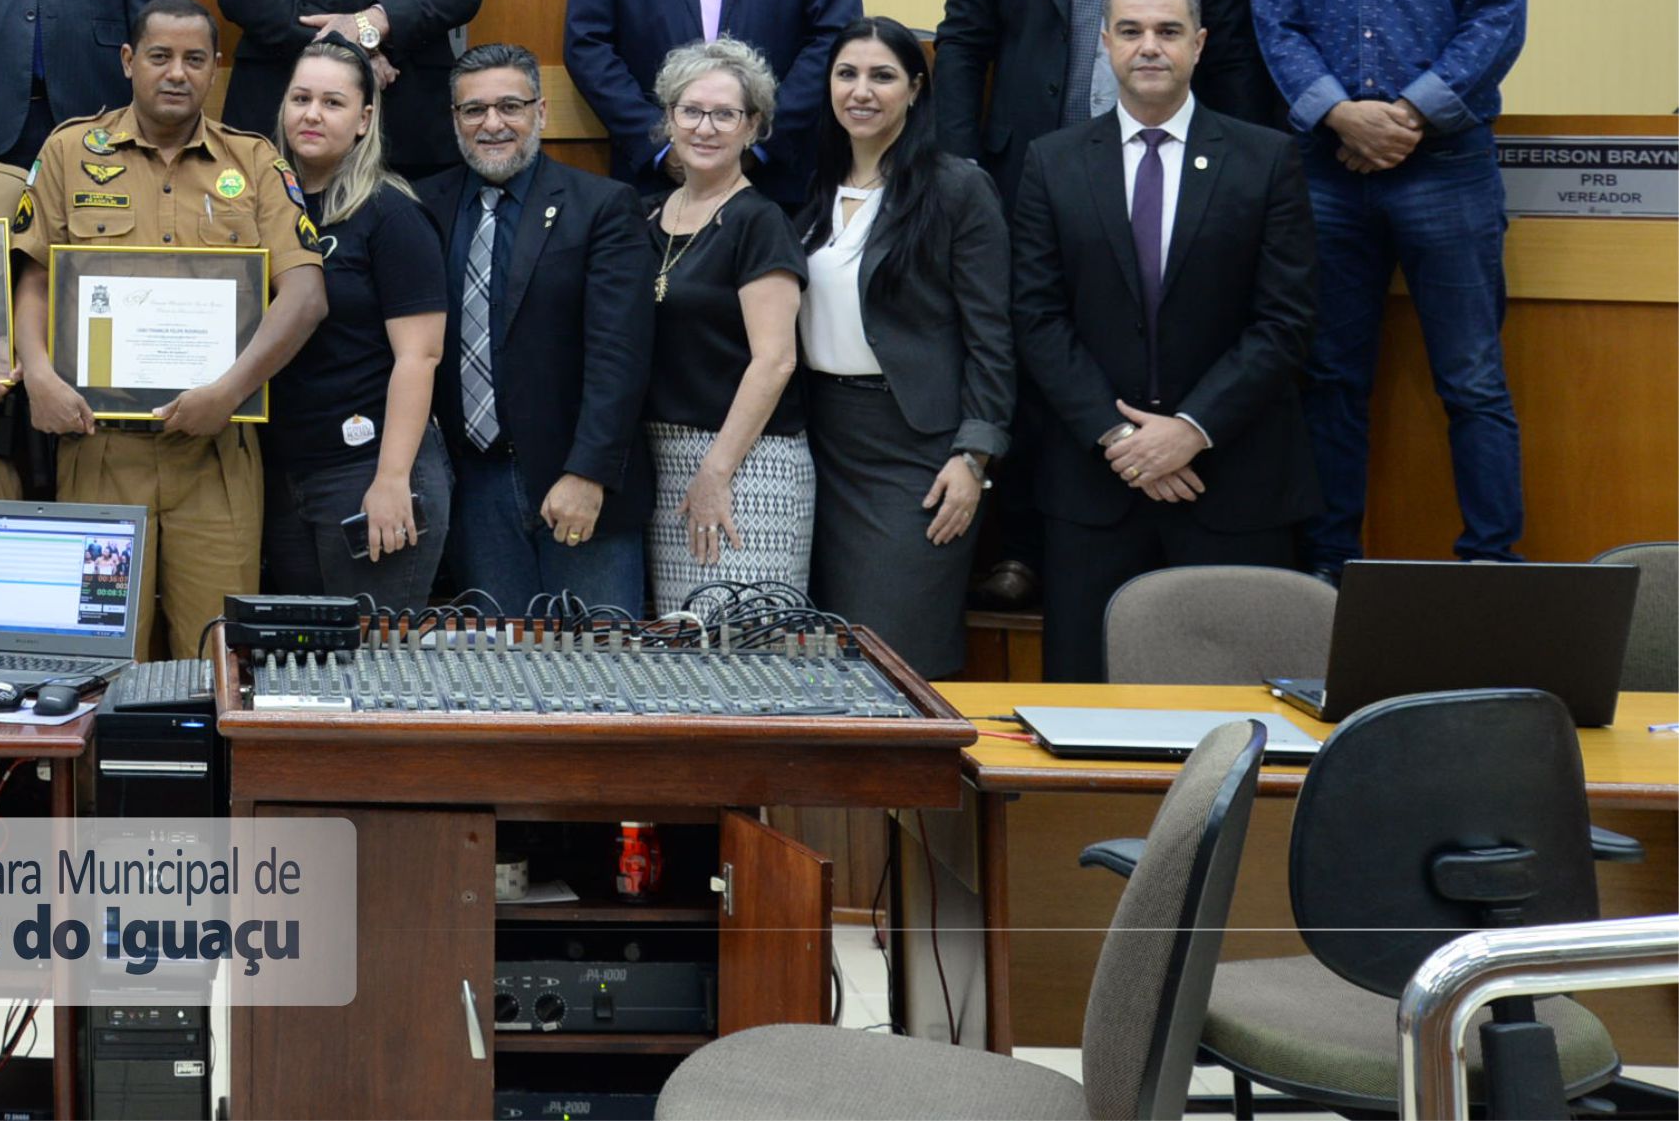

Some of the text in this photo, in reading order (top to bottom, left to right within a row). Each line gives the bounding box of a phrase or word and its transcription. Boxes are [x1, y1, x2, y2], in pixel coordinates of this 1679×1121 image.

[1498, 148, 1602, 164] JEFERSON
[1580, 173, 1618, 187] PRB
[1557, 191, 1642, 204] VEREADOR
